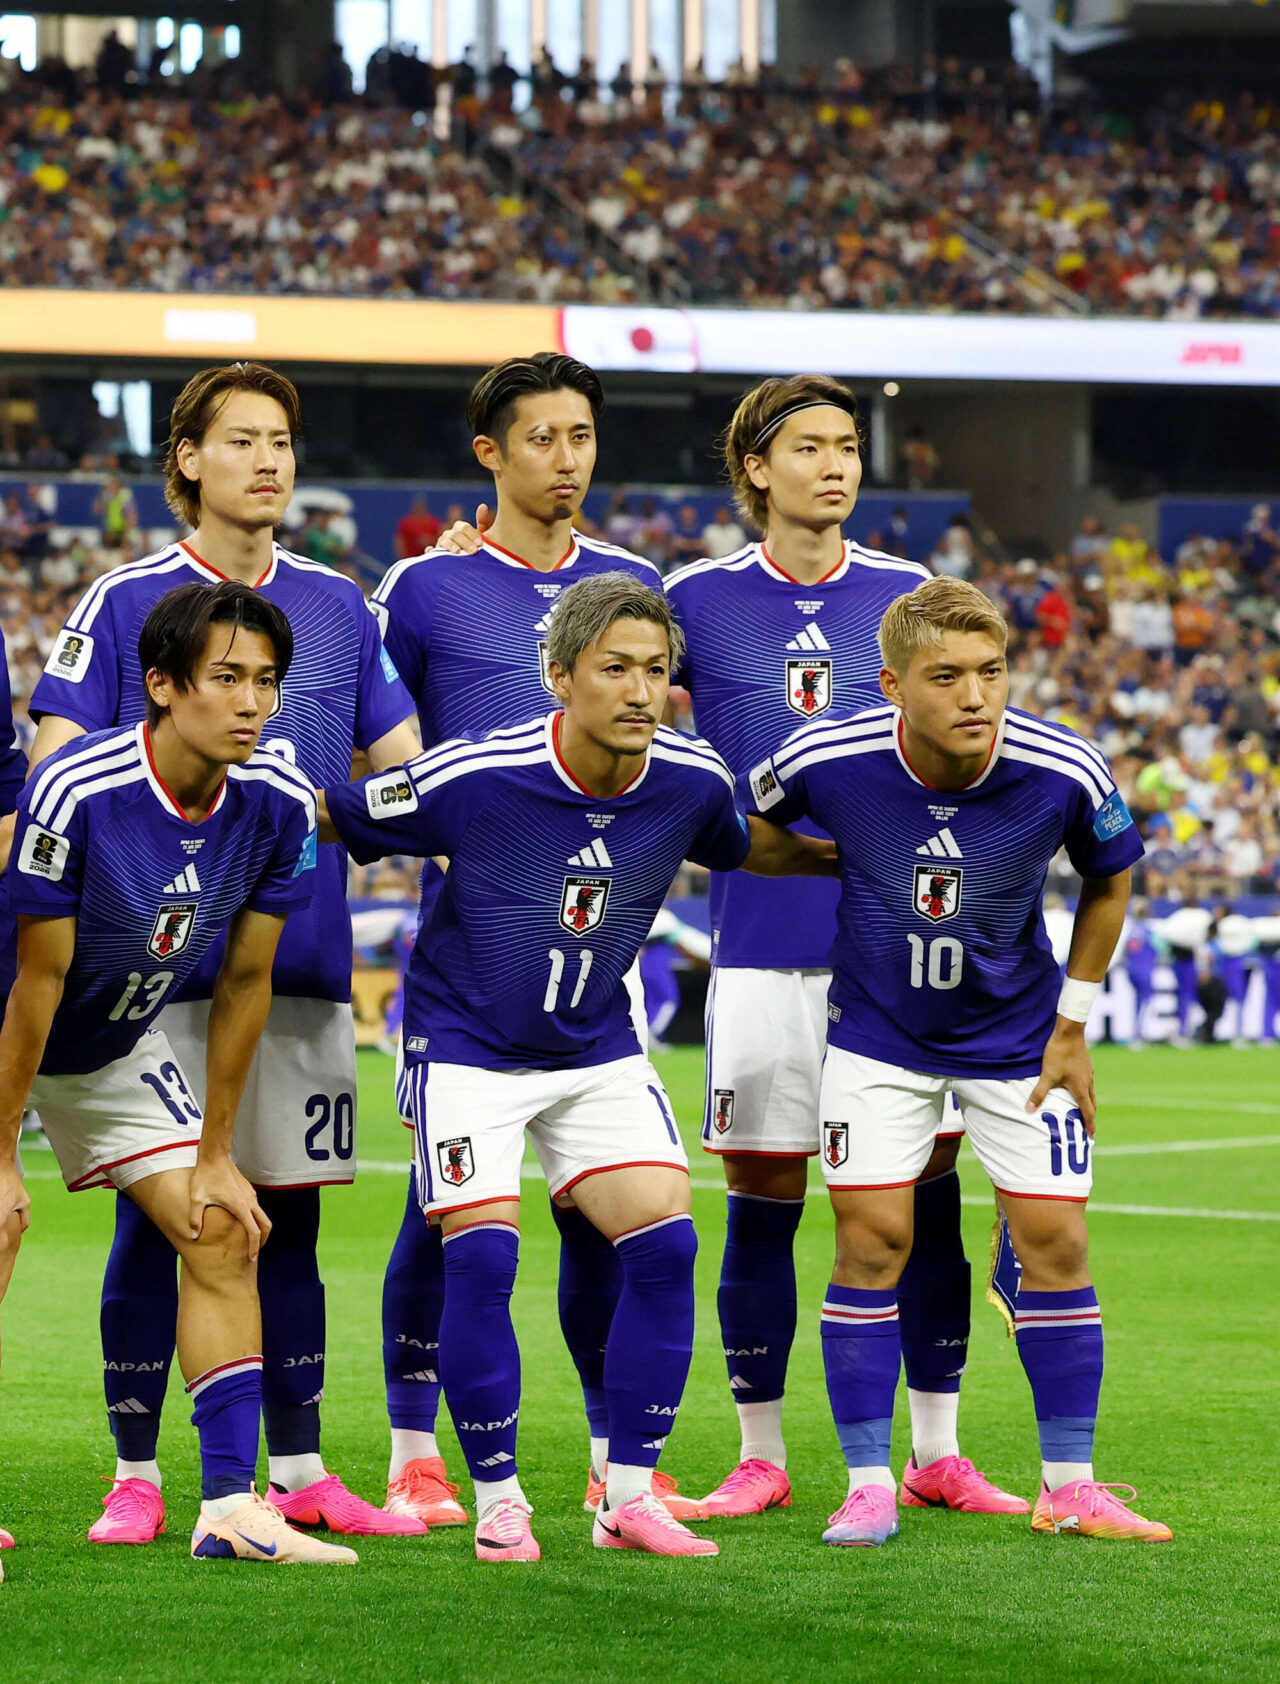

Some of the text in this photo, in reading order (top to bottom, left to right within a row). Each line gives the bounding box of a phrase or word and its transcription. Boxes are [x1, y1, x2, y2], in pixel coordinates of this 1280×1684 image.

[52, 668, 72, 677] 2026
[799, 699, 818, 708] JFA
[1104, 816, 1124, 830] PEACE
[29, 865, 50, 875] 2026
[570, 917, 589, 926] JFA
[907, 933, 964, 990] 10
[543, 948, 594, 1013] 11
[108, 971, 174, 1021] 13
[140, 1061, 202, 1126] 13
[647, 1084, 678, 1146] 1
[305, 1093, 353, 1161] 20
[443, 1139, 463, 1147] JAPAN
[1041, 1108, 1089, 1177] 10
[395, 1334, 439, 1350] JAP
[724, 1346, 768, 1356] PAN
[283, 1354, 325, 1368] JAP
[645, 1405, 679, 1416] JAP
[460, 1410, 518, 1431] JAPAN
